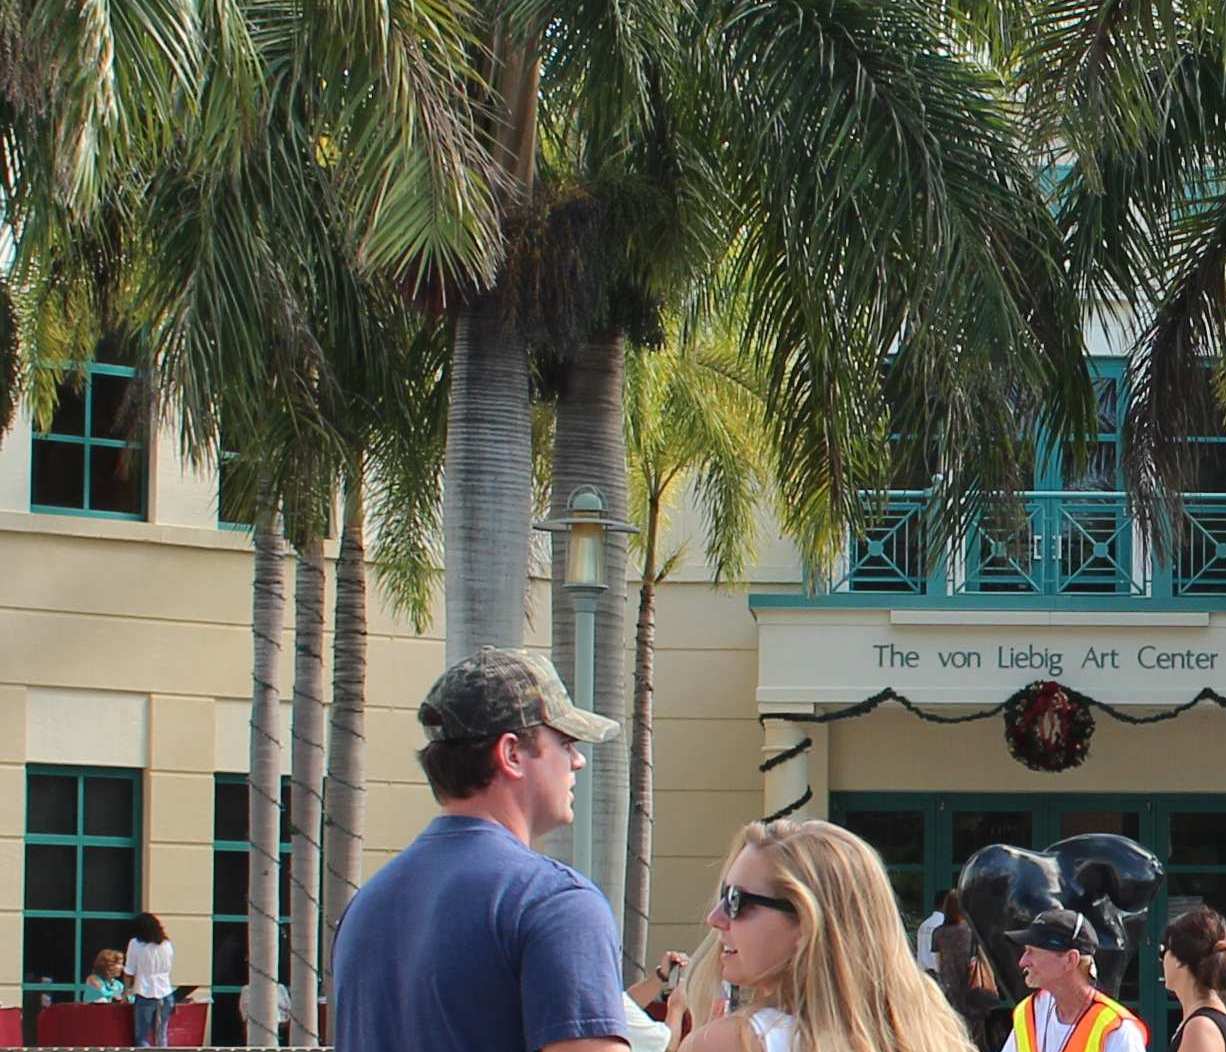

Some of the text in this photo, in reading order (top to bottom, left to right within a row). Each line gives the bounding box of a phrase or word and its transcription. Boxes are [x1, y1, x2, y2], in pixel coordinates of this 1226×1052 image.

[872, 643, 1219, 677] The von Liebig Art Center
